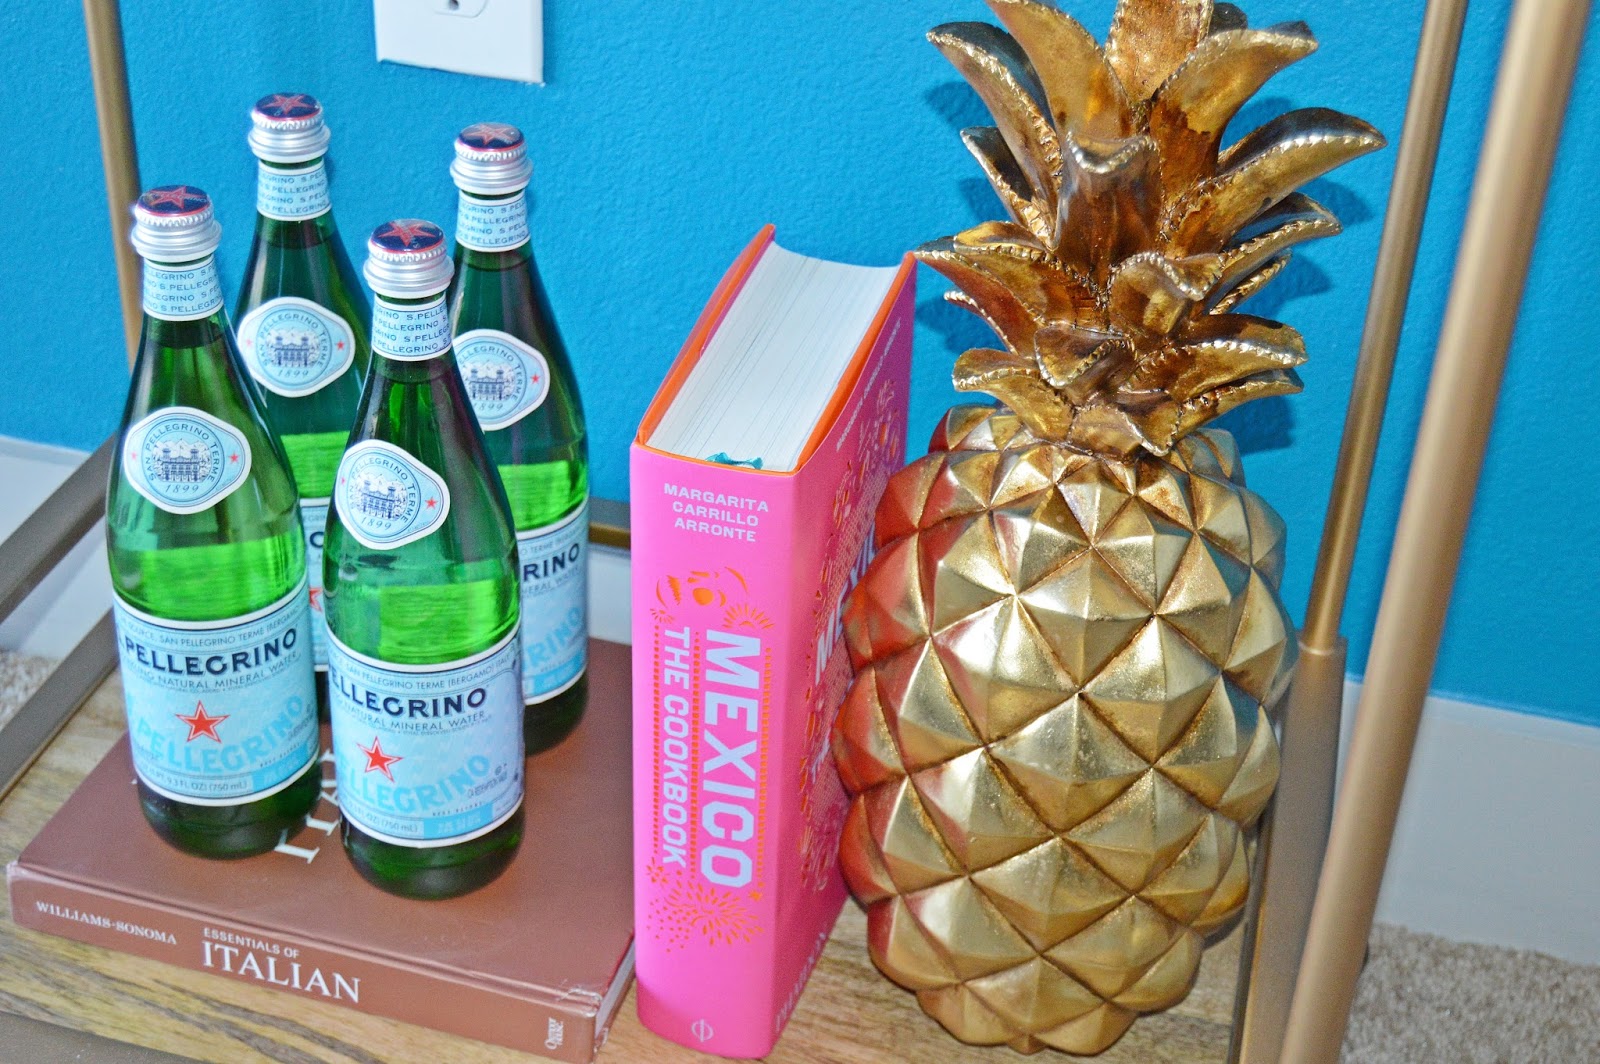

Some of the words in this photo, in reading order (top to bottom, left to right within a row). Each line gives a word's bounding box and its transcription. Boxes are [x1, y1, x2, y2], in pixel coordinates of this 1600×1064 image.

[145, 423, 210, 452] PELLEGRINO
[145, 456, 158, 481] SAN
[209, 441, 220, 482] TERME
[165, 484, 200, 494] 1899
[401, 483, 417, 524] TERME
[664, 483, 769, 513] MARGARITA
[361, 516, 392, 530] 1899
[672, 501, 759, 527] CARRILLO
[674, 517, 756, 543] ARRONTE
[160, 635, 178, 645] SAN
[181, 635, 236, 647] PELLEGRINO
[239, 628, 265, 641] TERME
[158, 675, 208, 690] NATURAL
[214, 668, 264, 688] MINERAL
[269, 650, 298, 673] WATER
[664, 627, 690, 690] THE
[362, 670, 414, 690] PELLEGRINO
[416, 679, 445, 690] TERME
[391, 720, 444, 733] MINERAL
[448, 710, 485, 728] WATER
[701, 629, 761, 888] MEXICO
[662, 694, 689, 868] COOKBOOK
[36, 900, 177, 945] WILLIAMS-SONOMA
[203, 926, 280, 955] ESSENTIALS
[284, 947, 299, 960] OF
[202, 940, 361, 1004] ITALIAN
